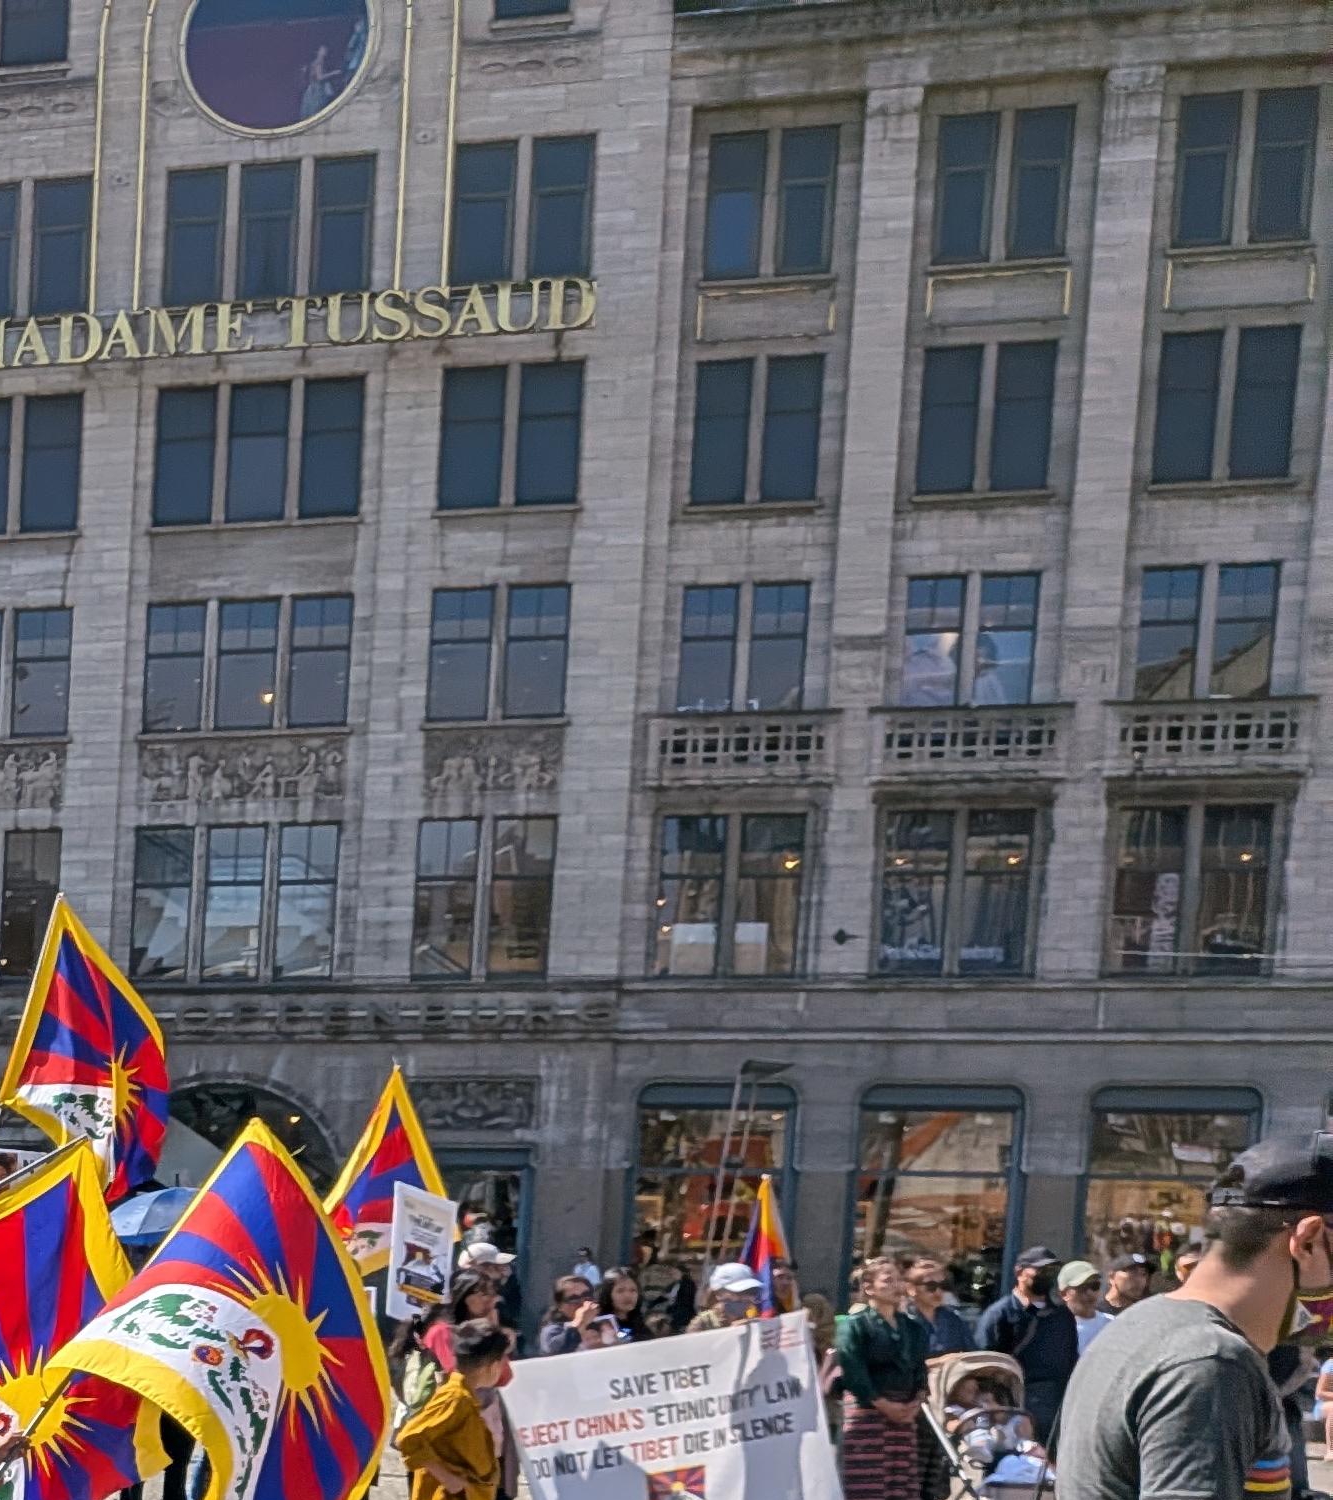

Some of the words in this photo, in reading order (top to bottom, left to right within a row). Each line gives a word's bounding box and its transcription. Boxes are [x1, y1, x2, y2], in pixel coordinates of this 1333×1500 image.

[275, 277, 597, 348] TUSSAUD
[610, 1374, 658, 1401] SAVE
[661, 1363, 711, 1392] TIBET
[517, 1420, 570, 1448] EJECT
[575, 1408, 645, 1440] CHINA'S
[763, 1376, 802, 1404] LAW
[554, 1450, 587, 1476] NOT
[593, 1445, 624, 1470] LET
[629, 1434, 679, 1463] TIBET
[683, 1430, 711, 1456] DIE
